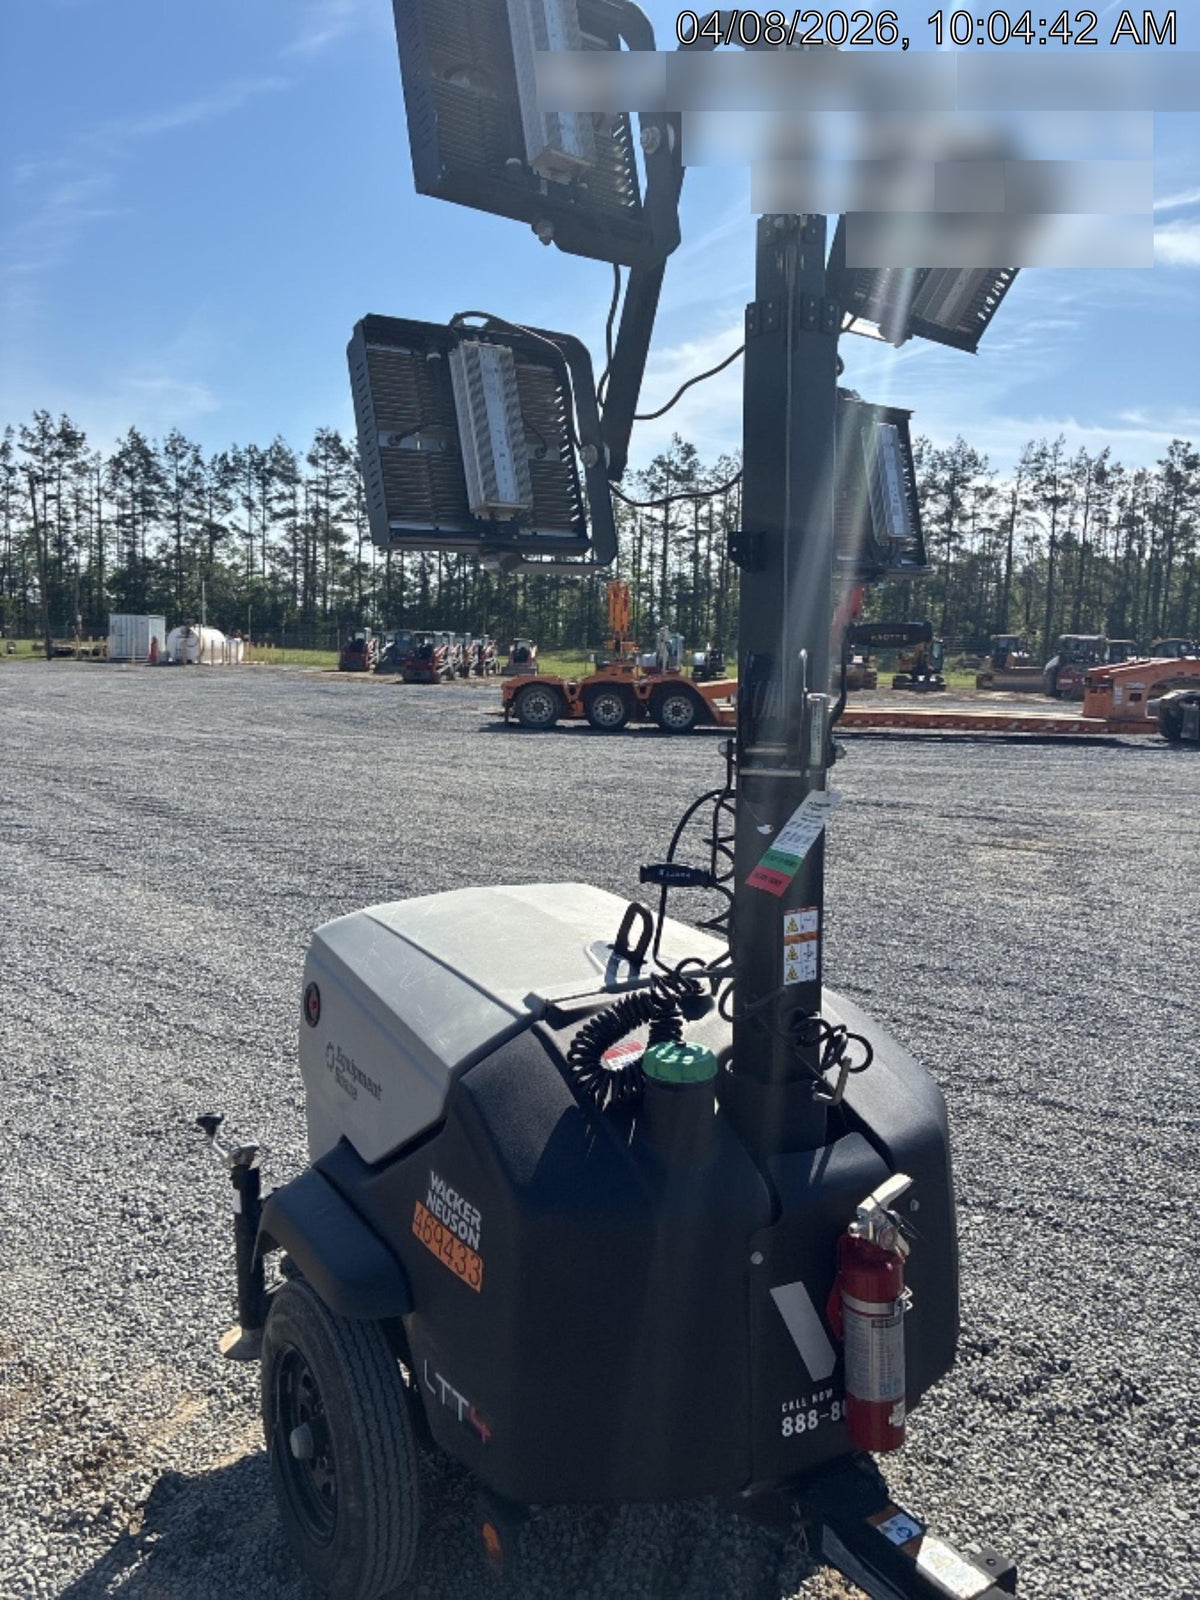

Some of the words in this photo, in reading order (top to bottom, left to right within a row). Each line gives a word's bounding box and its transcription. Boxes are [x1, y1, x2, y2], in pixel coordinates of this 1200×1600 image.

[426, 1189, 481, 1251] NEUSON
[430, 1169, 482, 1231] WACKER
[413, 1206, 481, 1287] 469433
[781, 1401, 807, 1413] CALL
[781, 1401, 846, 1437] 888-8
